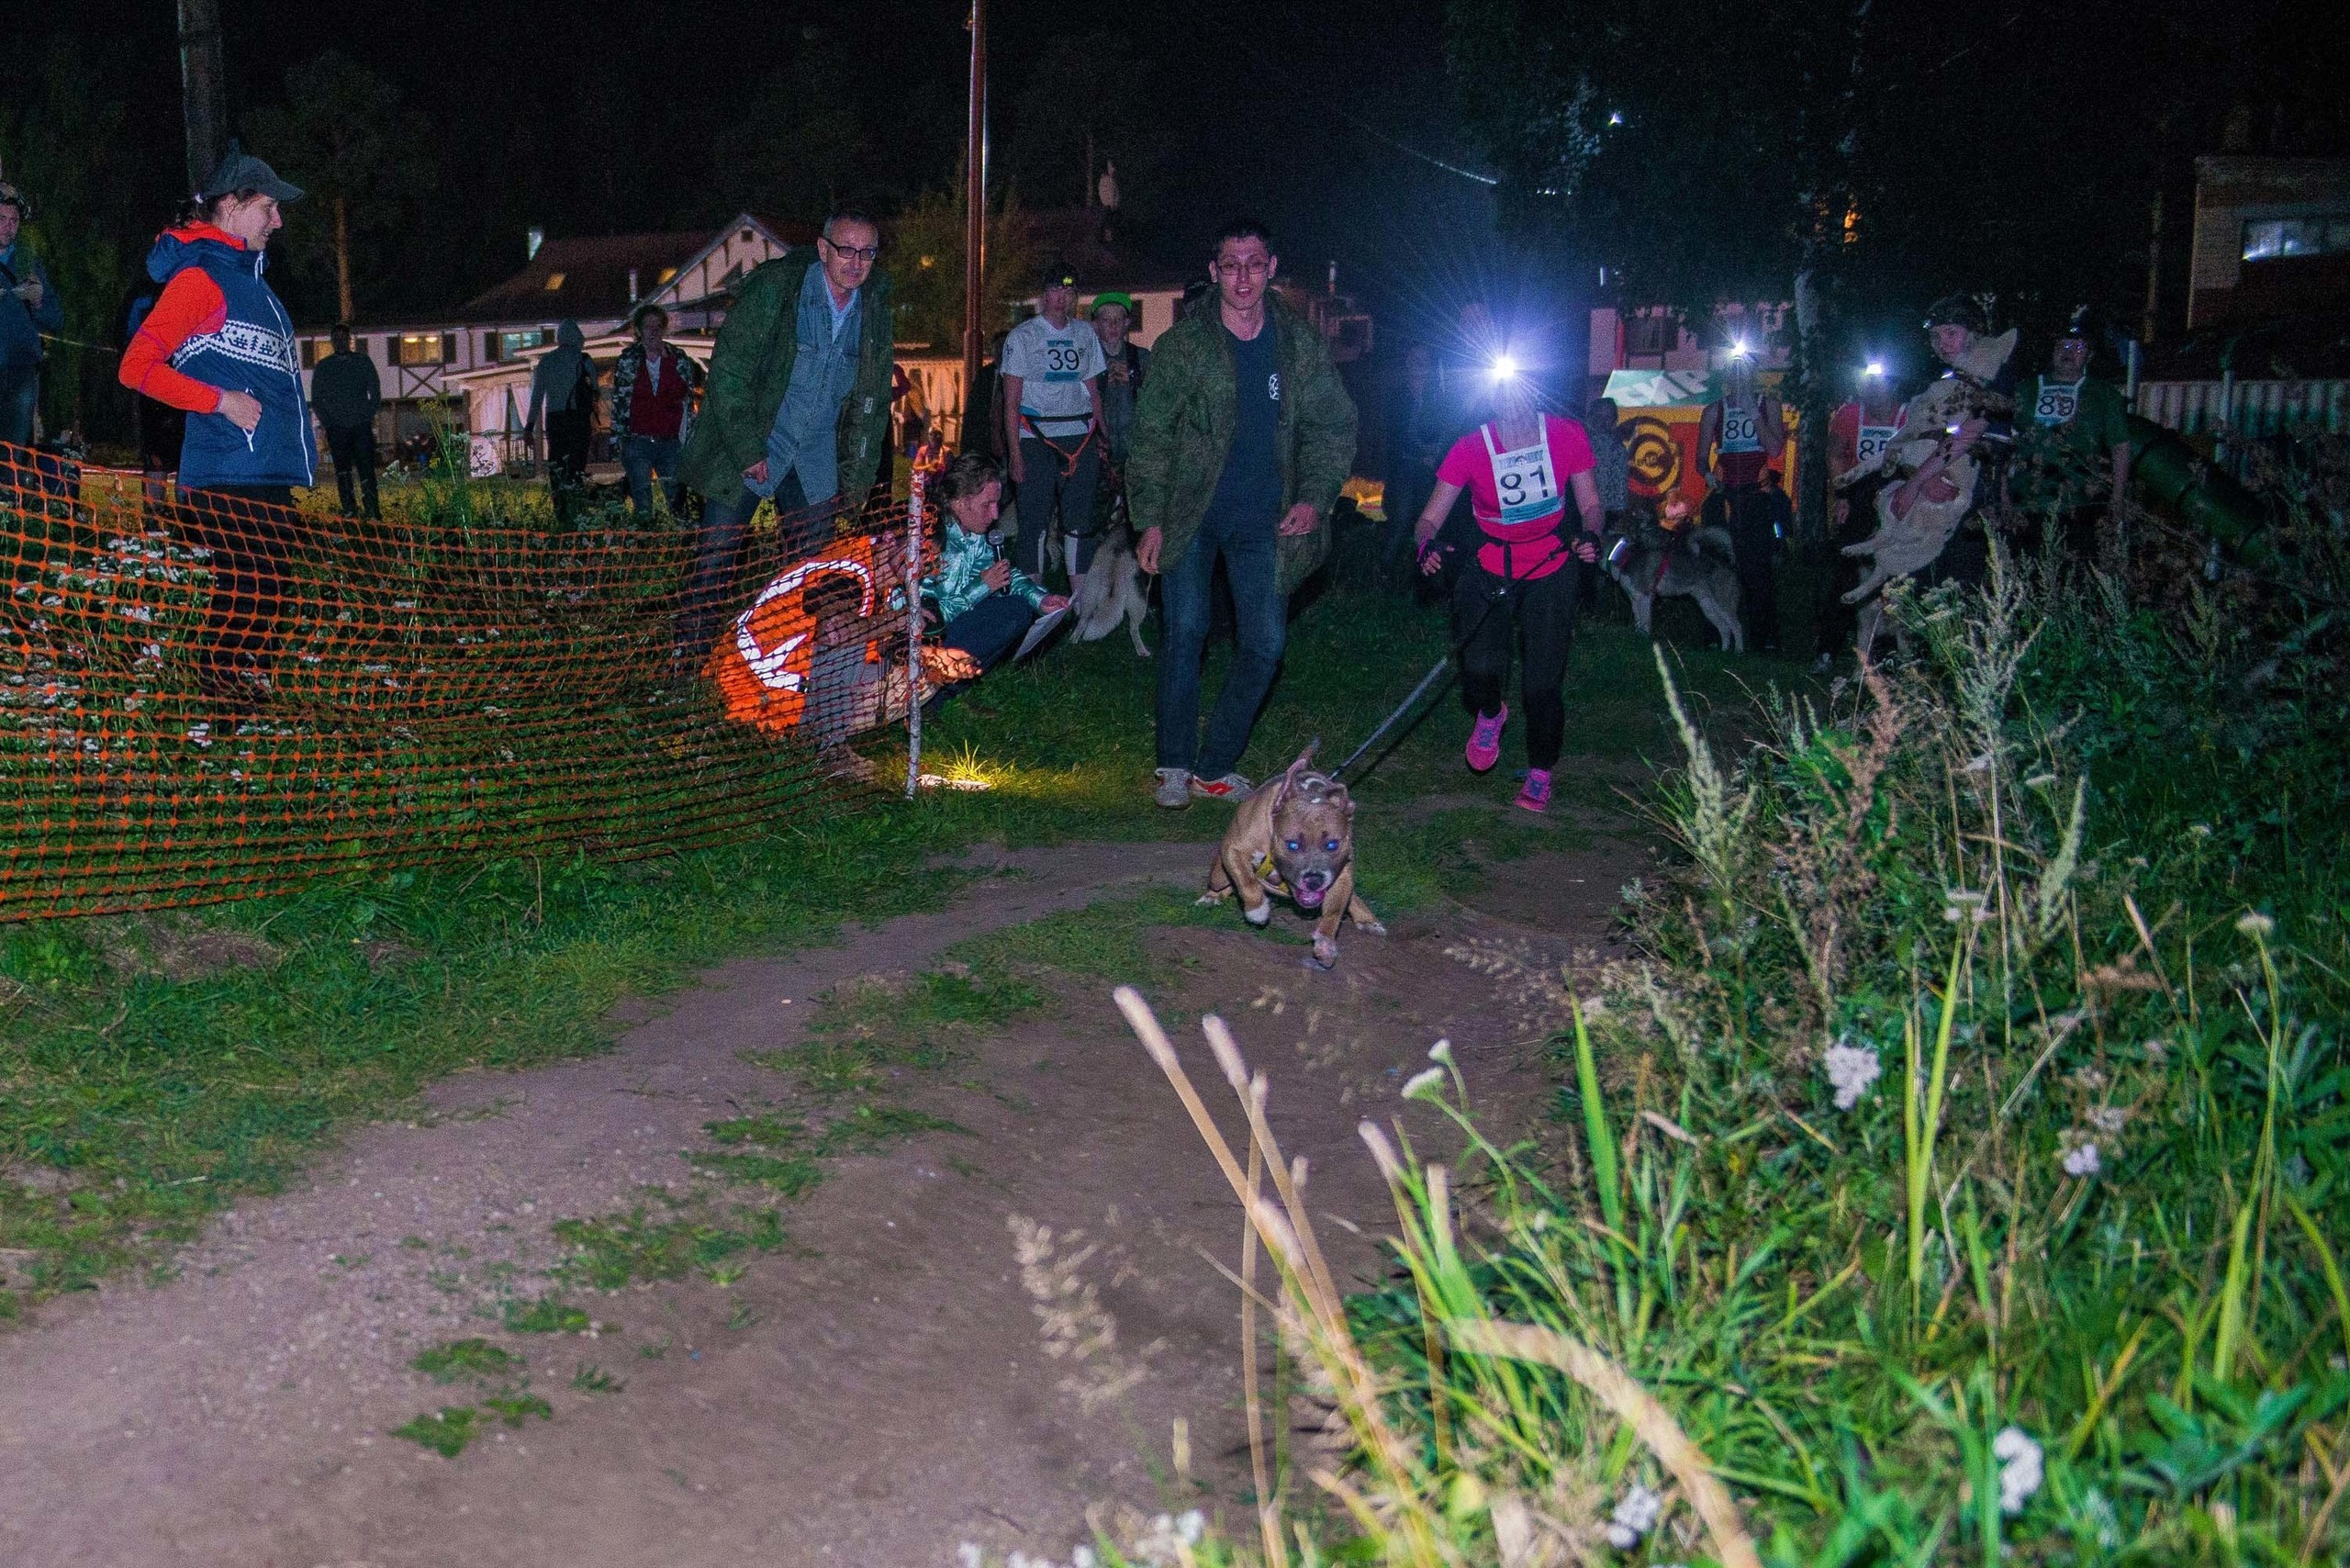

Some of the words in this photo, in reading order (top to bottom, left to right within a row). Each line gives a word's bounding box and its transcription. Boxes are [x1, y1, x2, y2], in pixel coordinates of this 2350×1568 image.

[1047, 349, 1080, 371] 39
[1725, 419, 1755, 440] 80
[1500, 465, 1549, 506] 81
